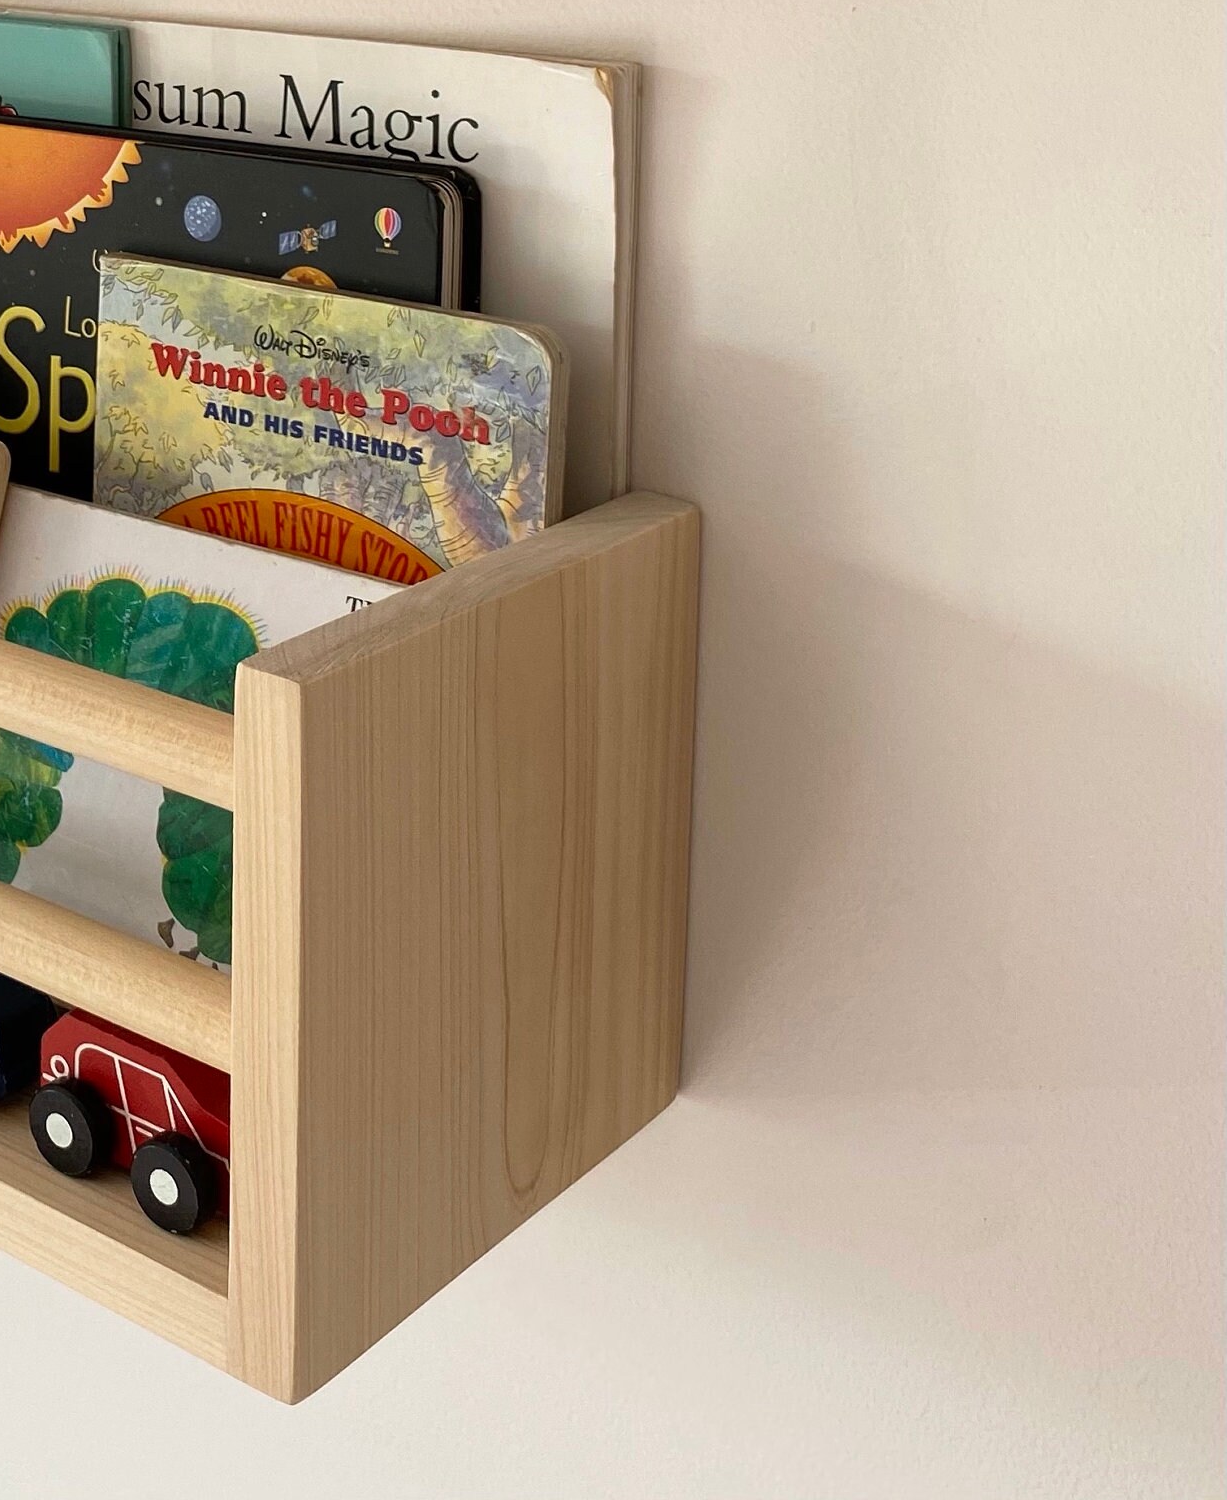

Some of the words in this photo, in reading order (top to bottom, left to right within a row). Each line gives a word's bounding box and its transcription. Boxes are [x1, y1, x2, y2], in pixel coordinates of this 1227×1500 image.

[133, 78, 253, 134] sum
[274, 73, 479, 163] Magic
[151, 342, 288, 401] Winnie
[299, 376, 367, 418] the
[380, 388, 492, 446] Pooh
[203, 401, 254, 428] AND
[264, 414, 304, 439] HIS
[314, 424, 425, 466] FRIENDS
[272, 501, 354, 567] FISHY
